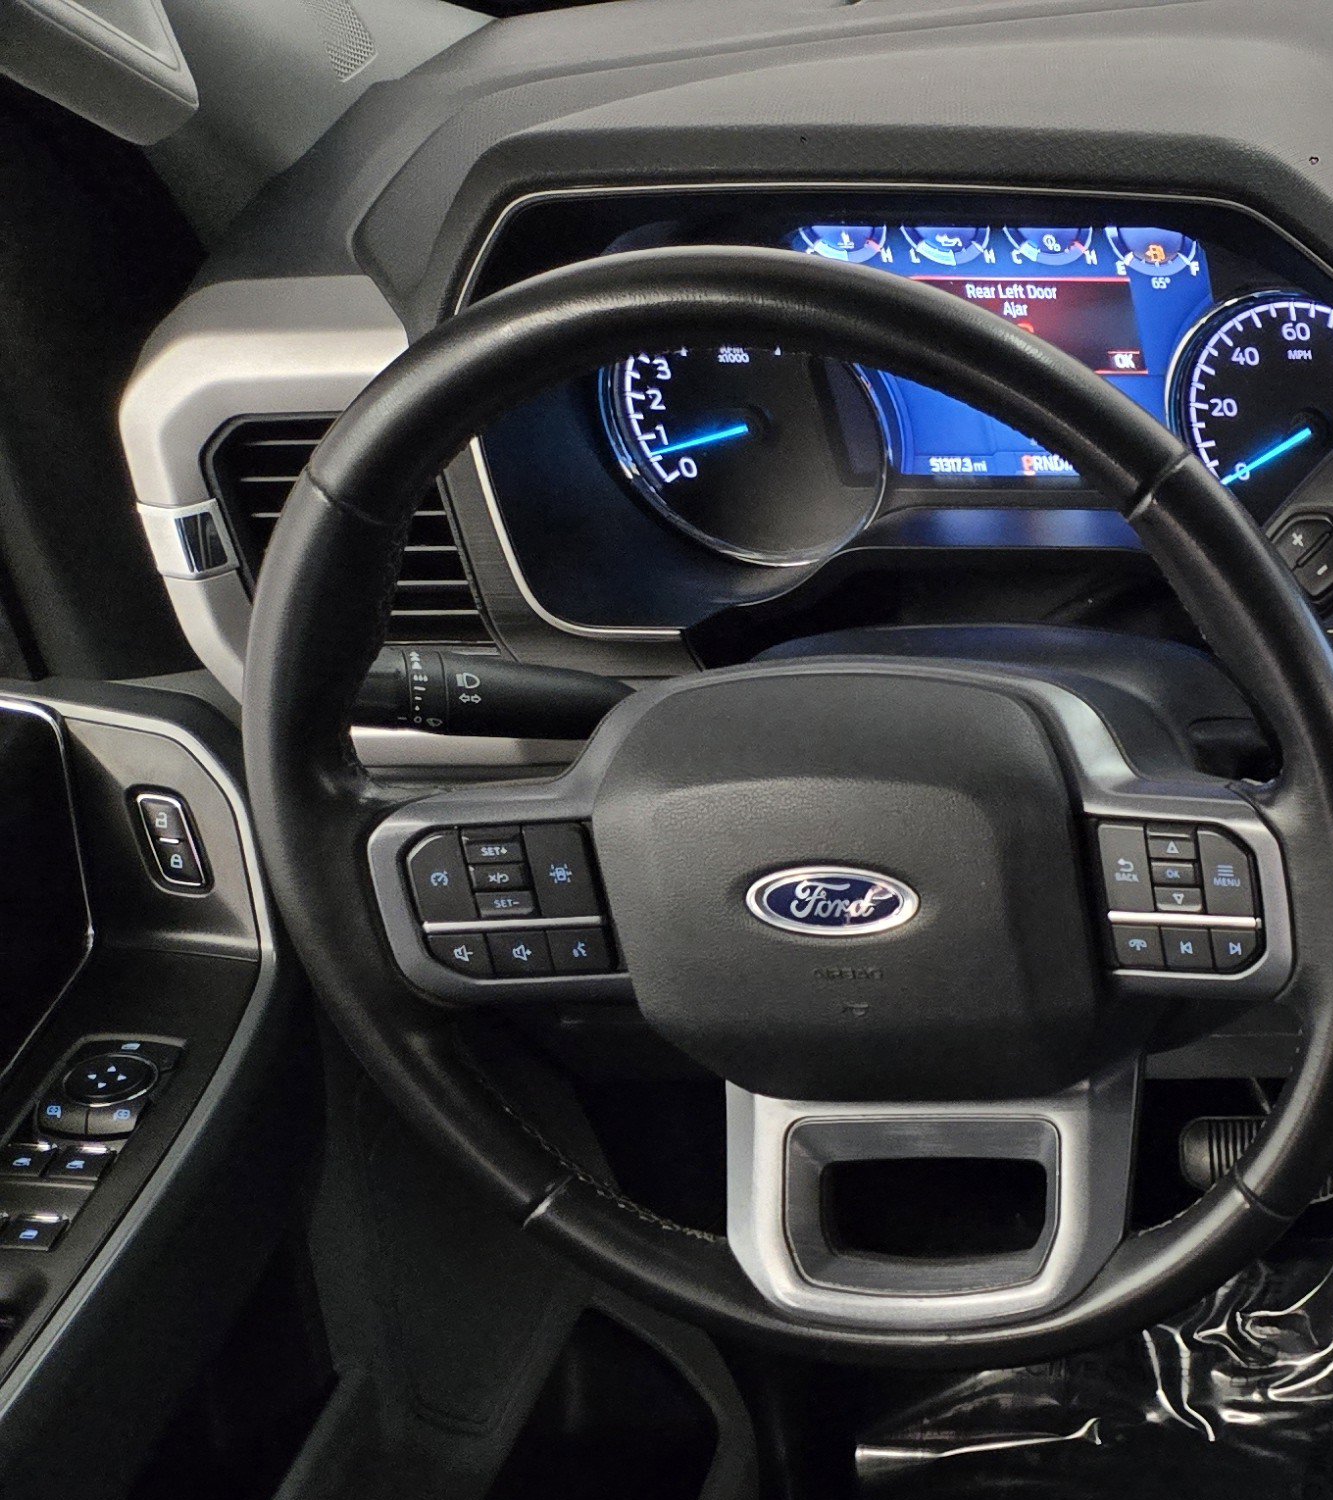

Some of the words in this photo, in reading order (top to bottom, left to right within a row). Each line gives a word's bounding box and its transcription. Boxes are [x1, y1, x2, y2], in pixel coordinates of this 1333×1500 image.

[965, 284, 995, 299] Rear
[998, 284, 1025, 300] Left
[1027, 285, 1057, 300] Door
[1003, 301, 1028, 318] Ajar
[1281, 322, 1311, 341] 60
[1114, 355, 1135, 369] OK
[1231, 347, 1260, 366] 40
[1287, 349, 1312, 361] MPH
[652, 356, 672, 380] 3
[646, 387, 666, 410] 2
[1209, 398, 1238, 417] 20
[654, 424, 669, 445] 1
[678, 456, 698, 478] 0
[973, 460, 988, 473] mi
[1115, 872, 1139, 882] BACK
[1165, 869, 1181, 879] OK
[1212, 877, 1241, 887] MENU
[789, 879, 882, 918] Ford
